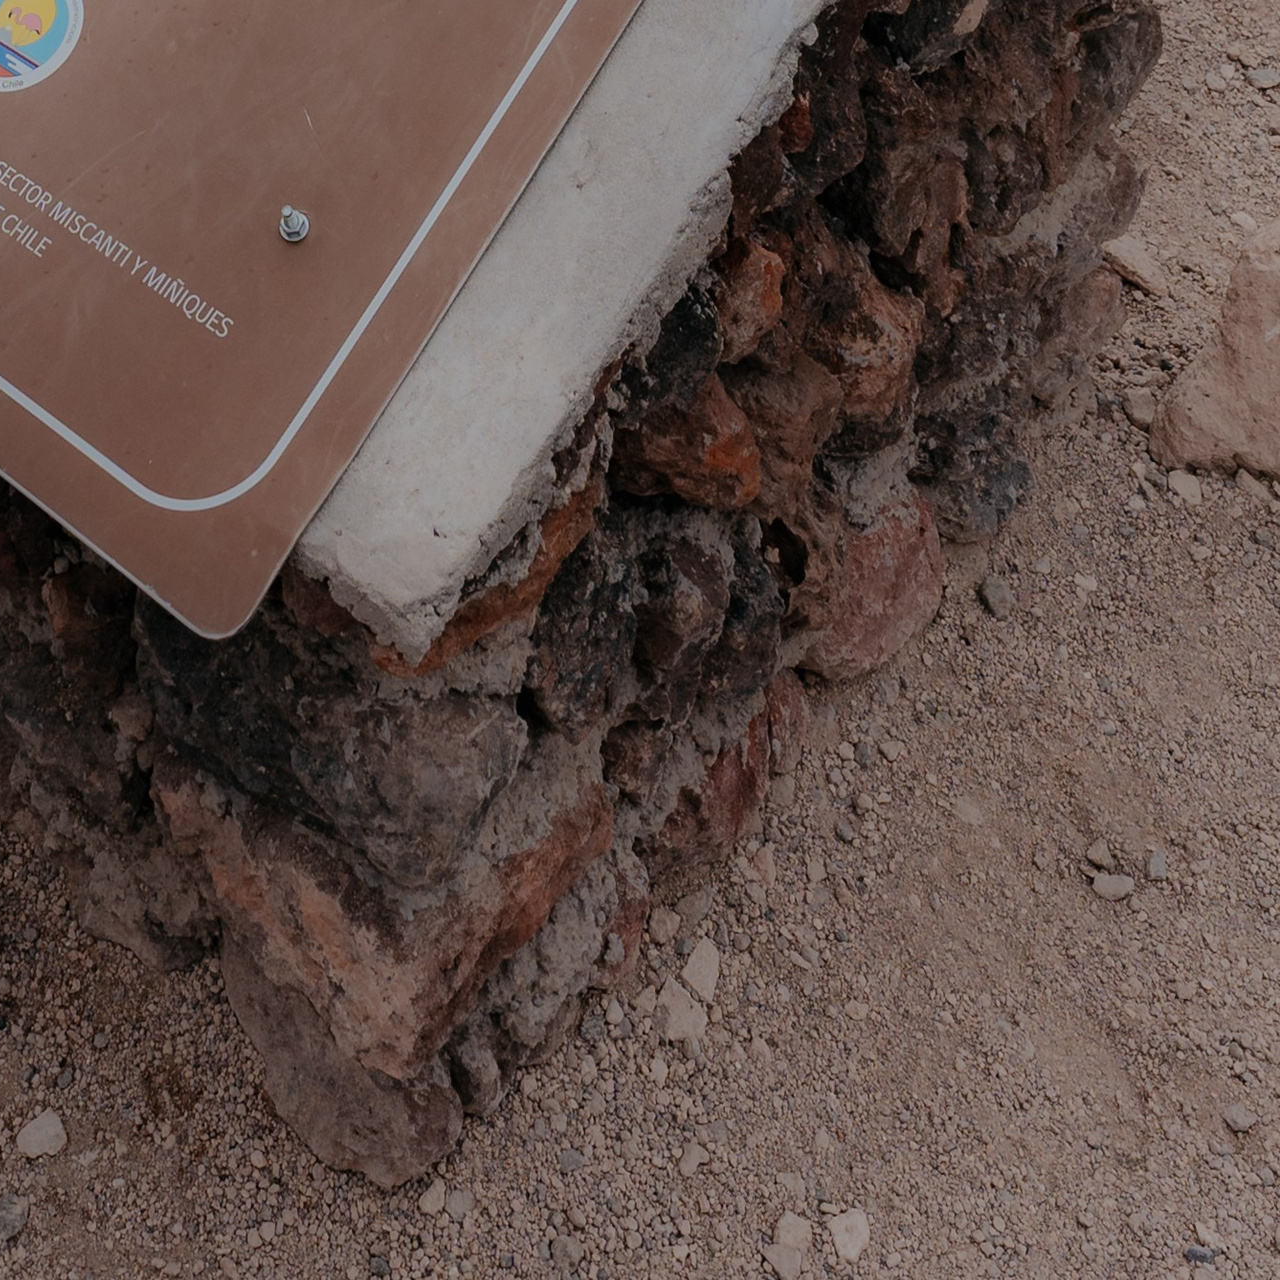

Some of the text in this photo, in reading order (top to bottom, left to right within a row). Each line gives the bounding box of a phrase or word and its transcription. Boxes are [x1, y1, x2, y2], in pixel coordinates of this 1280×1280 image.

[2, 79, 24, 89] Chile
[1, 213, 53, 258] CHILE
[48, 200, 133, 268] MISCANTI
[130, 255, 148, 275] Y
[142, 265, 234, 338] MIÑIQUES
